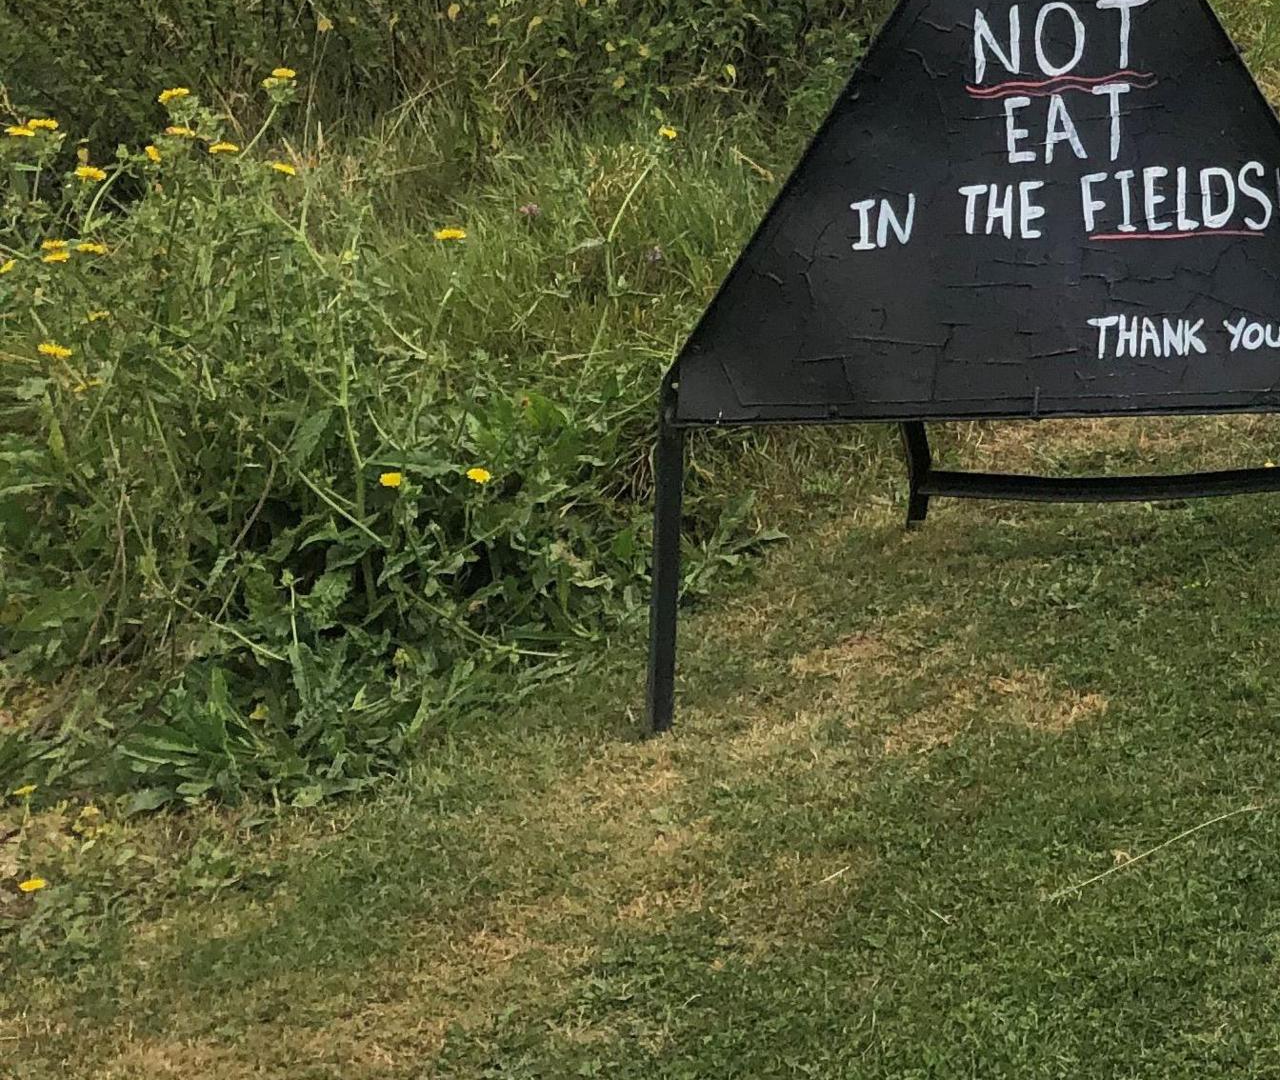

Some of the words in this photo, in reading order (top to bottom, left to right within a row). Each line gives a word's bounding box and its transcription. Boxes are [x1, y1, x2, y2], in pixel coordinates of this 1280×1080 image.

[1004, 83, 1131, 165] EAT
[850, 193, 915, 251] IN
[958, 180, 1046, 240] THE
[1087, 316, 1207, 360] THANK
